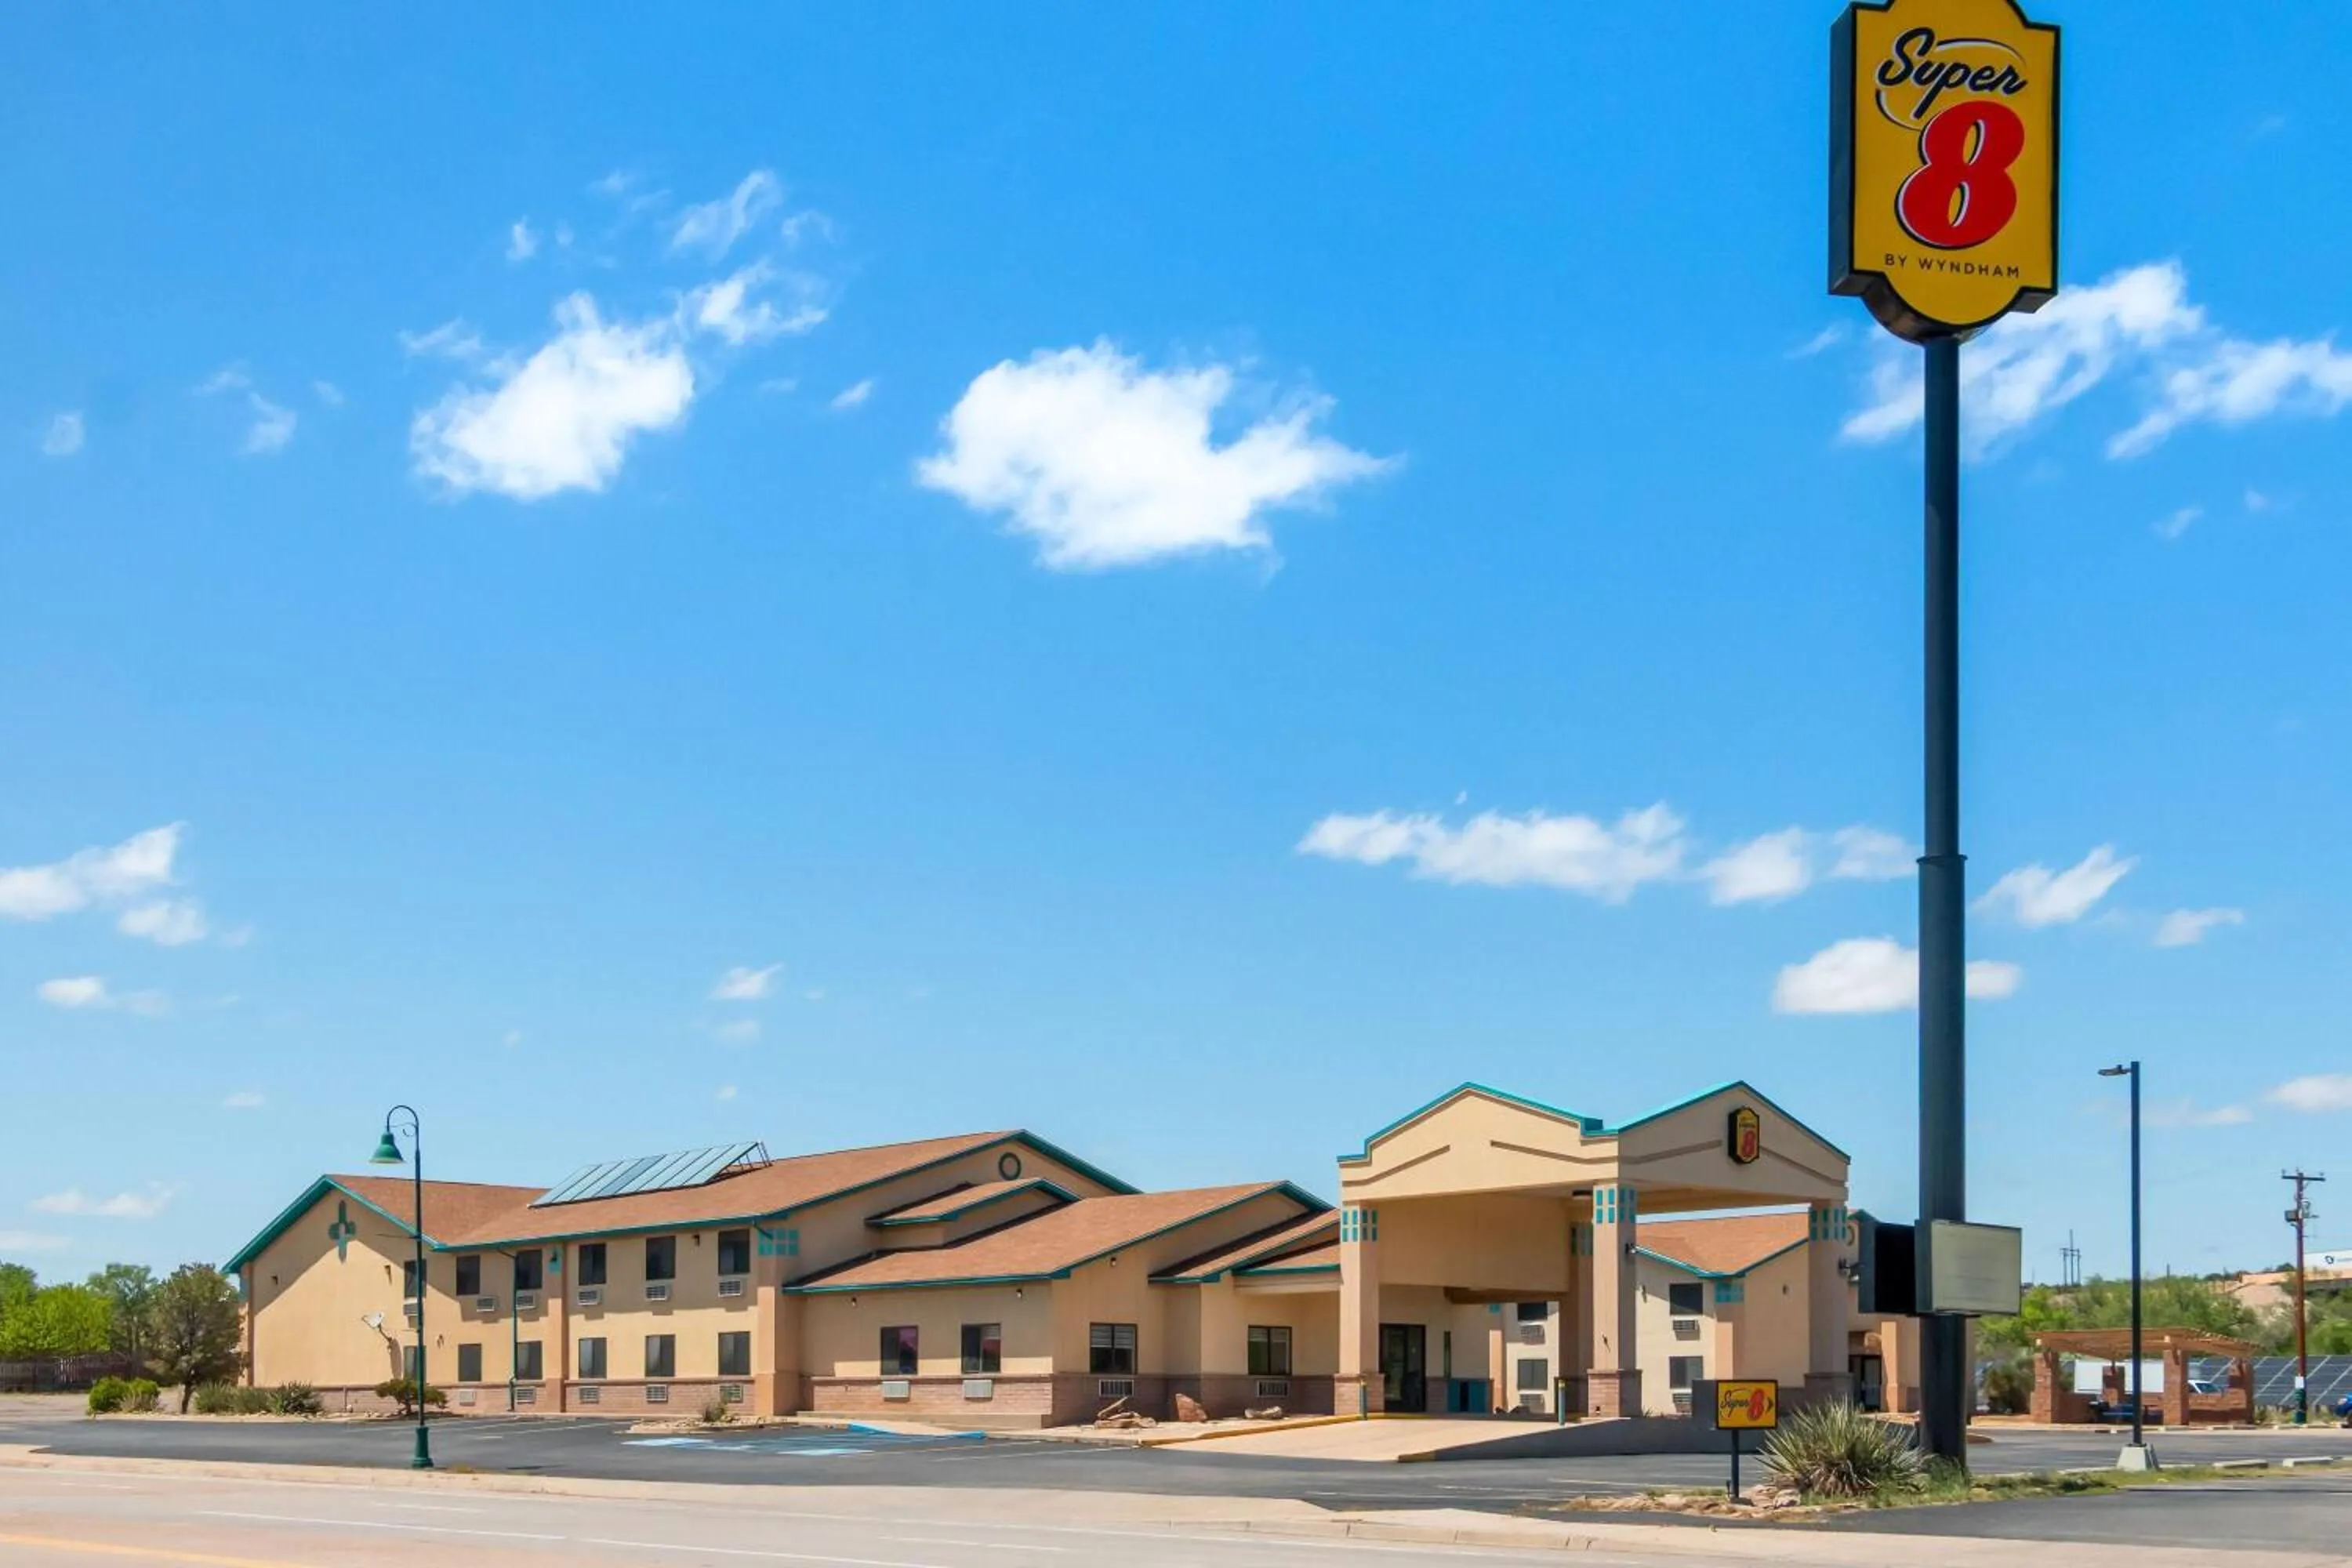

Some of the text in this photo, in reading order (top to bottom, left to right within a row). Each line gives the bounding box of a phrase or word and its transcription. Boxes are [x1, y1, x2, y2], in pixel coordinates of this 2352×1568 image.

[1878, 27, 2027, 119] Super
[1894, 100, 2025, 250] 8
[1884, 253, 2020, 278] BY WYNDHAM
[1747, 1388, 1764, 1421] 8
